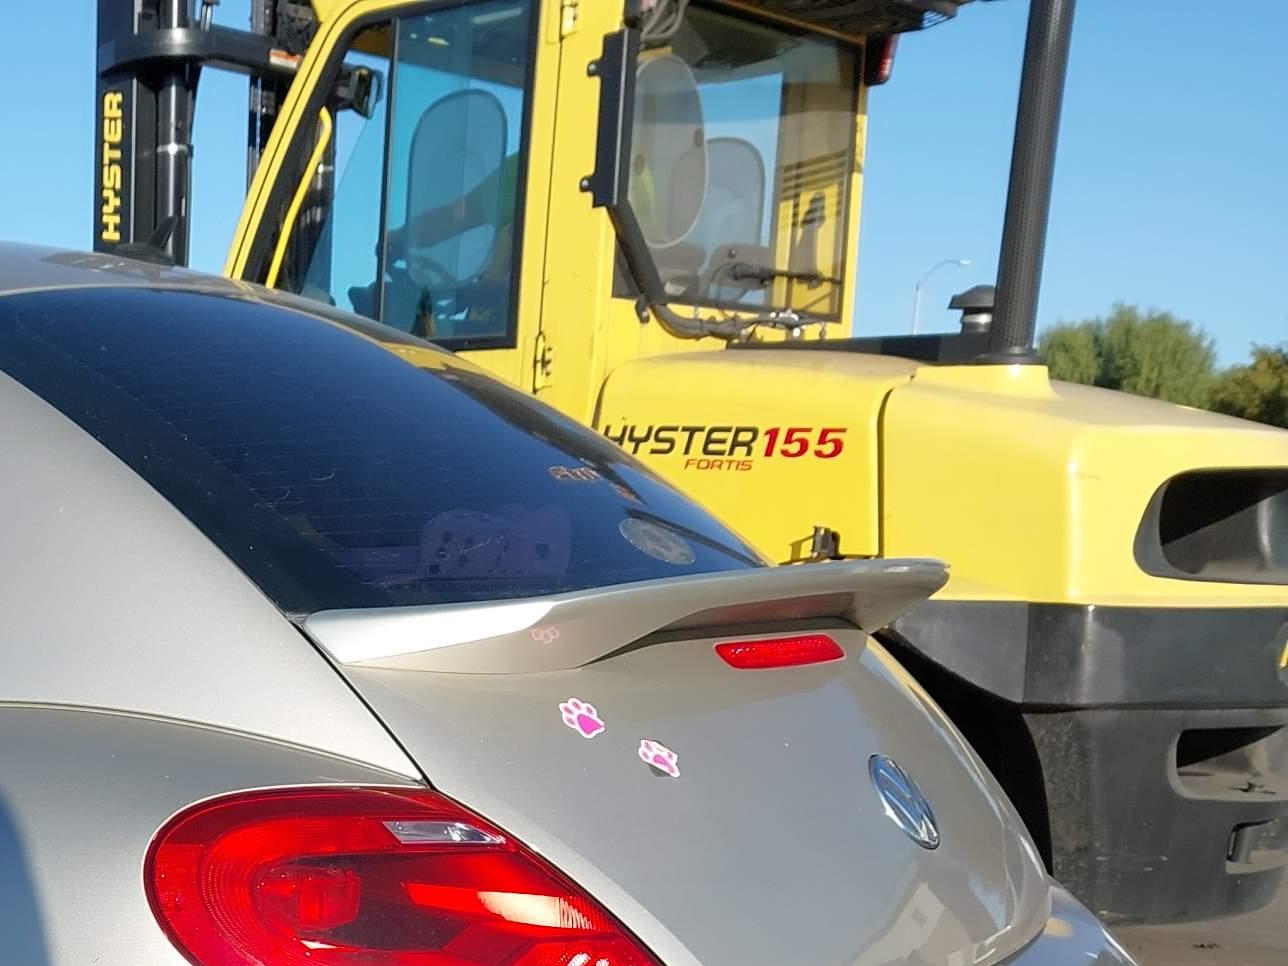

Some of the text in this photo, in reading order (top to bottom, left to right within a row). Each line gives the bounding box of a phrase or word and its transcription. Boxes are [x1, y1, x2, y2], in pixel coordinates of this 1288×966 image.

[102, 91, 123, 241] HYSTER
[763, 427, 848, 459] 155
[684, 458, 754, 471] FORTIS
